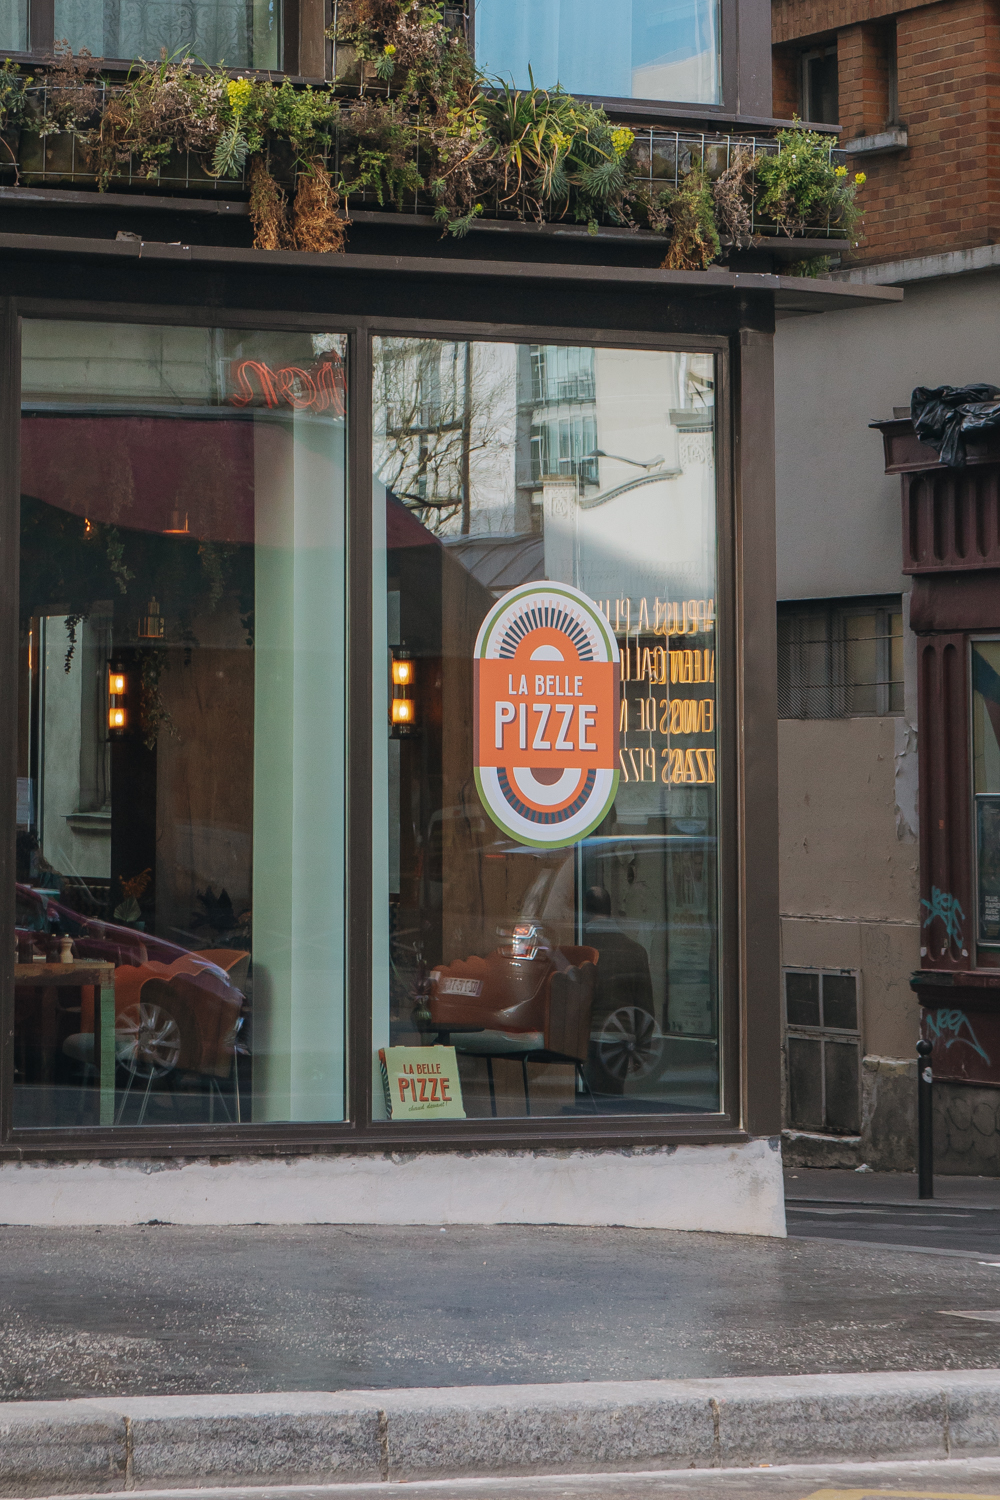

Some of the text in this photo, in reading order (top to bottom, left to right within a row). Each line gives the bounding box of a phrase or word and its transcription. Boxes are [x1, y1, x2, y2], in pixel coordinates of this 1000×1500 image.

[508, 674, 583, 697] LA BELLE
[494, 701, 598, 750] PIZZE
[403, 1063, 441, 1074] LA BELLE
[398, 1078, 452, 1102] PIZZE
